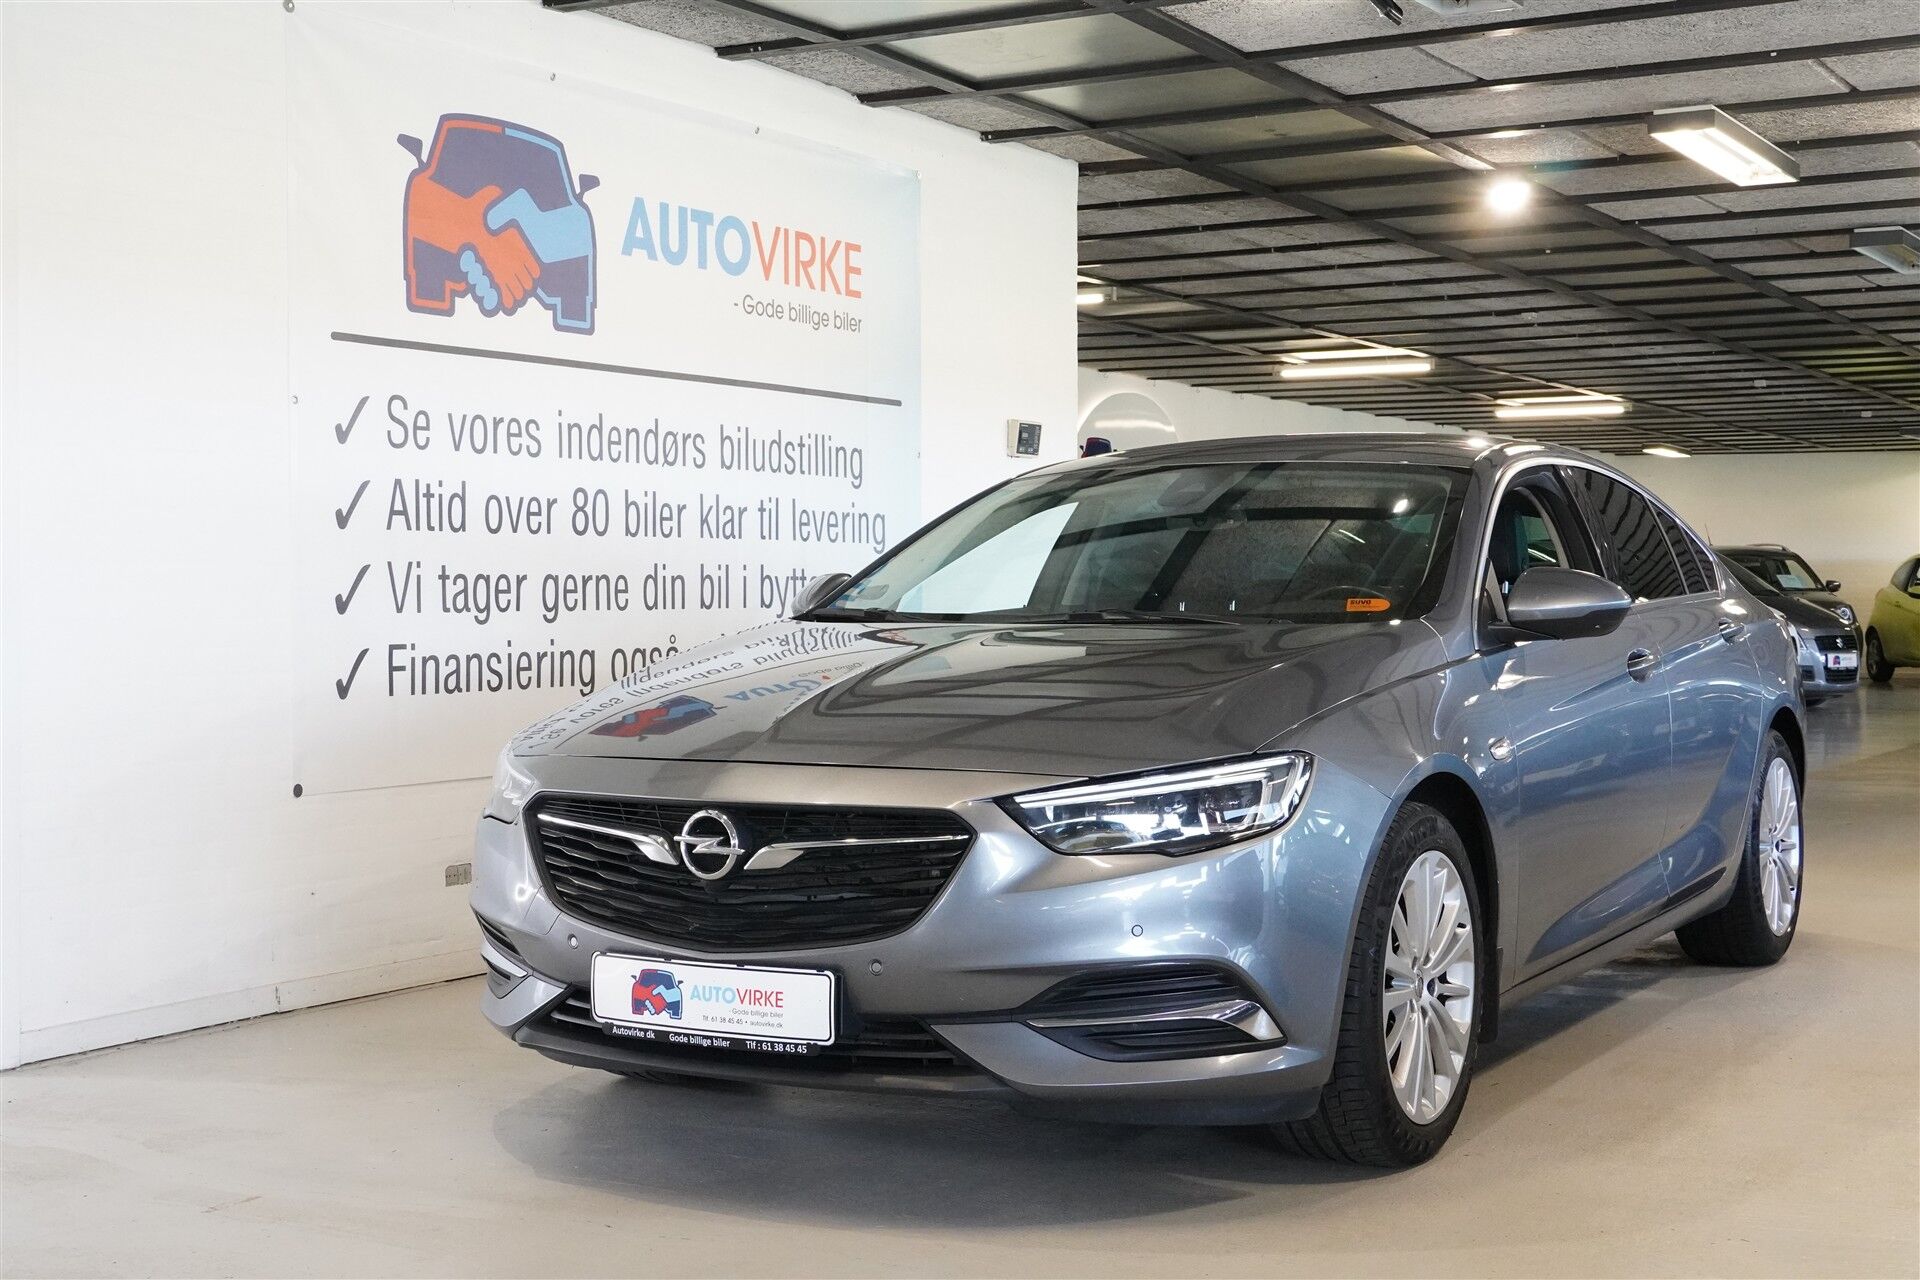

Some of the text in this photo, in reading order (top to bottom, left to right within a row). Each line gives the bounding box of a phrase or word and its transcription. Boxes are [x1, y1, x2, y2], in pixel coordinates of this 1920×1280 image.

[621, 196, 864, 300] AUTOVIRKE
[743, 294, 785, 320] Gode
[788, 302, 830, 331] billige
[833, 310, 863, 333] biler
[386, 394, 863, 488] Se vores indendørs biludstilling
[386, 477, 887, 553] Altid over 80 biler klar til levering
[386, 560, 817, 626] Vi tager gerne din bil i bytt
[387, 639, 597, 697] Finansiering
[690, 985, 784, 1008] AUTOVIRKE
[612, 1026, 645, 1038] Autovirke
[711, 1015, 718, 1023] 61
[719, 1016, 726, 1024] 38
[727, 1017, 735, 1025] 45
[669, 1033, 730, 1048] Gode billige biler
[762, 1041, 772, 1051] 61
[774, 1042, 784, 1052] 38
[785, 1043, 795, 1053] 45
[797, 1043, 807, 1054] 45
